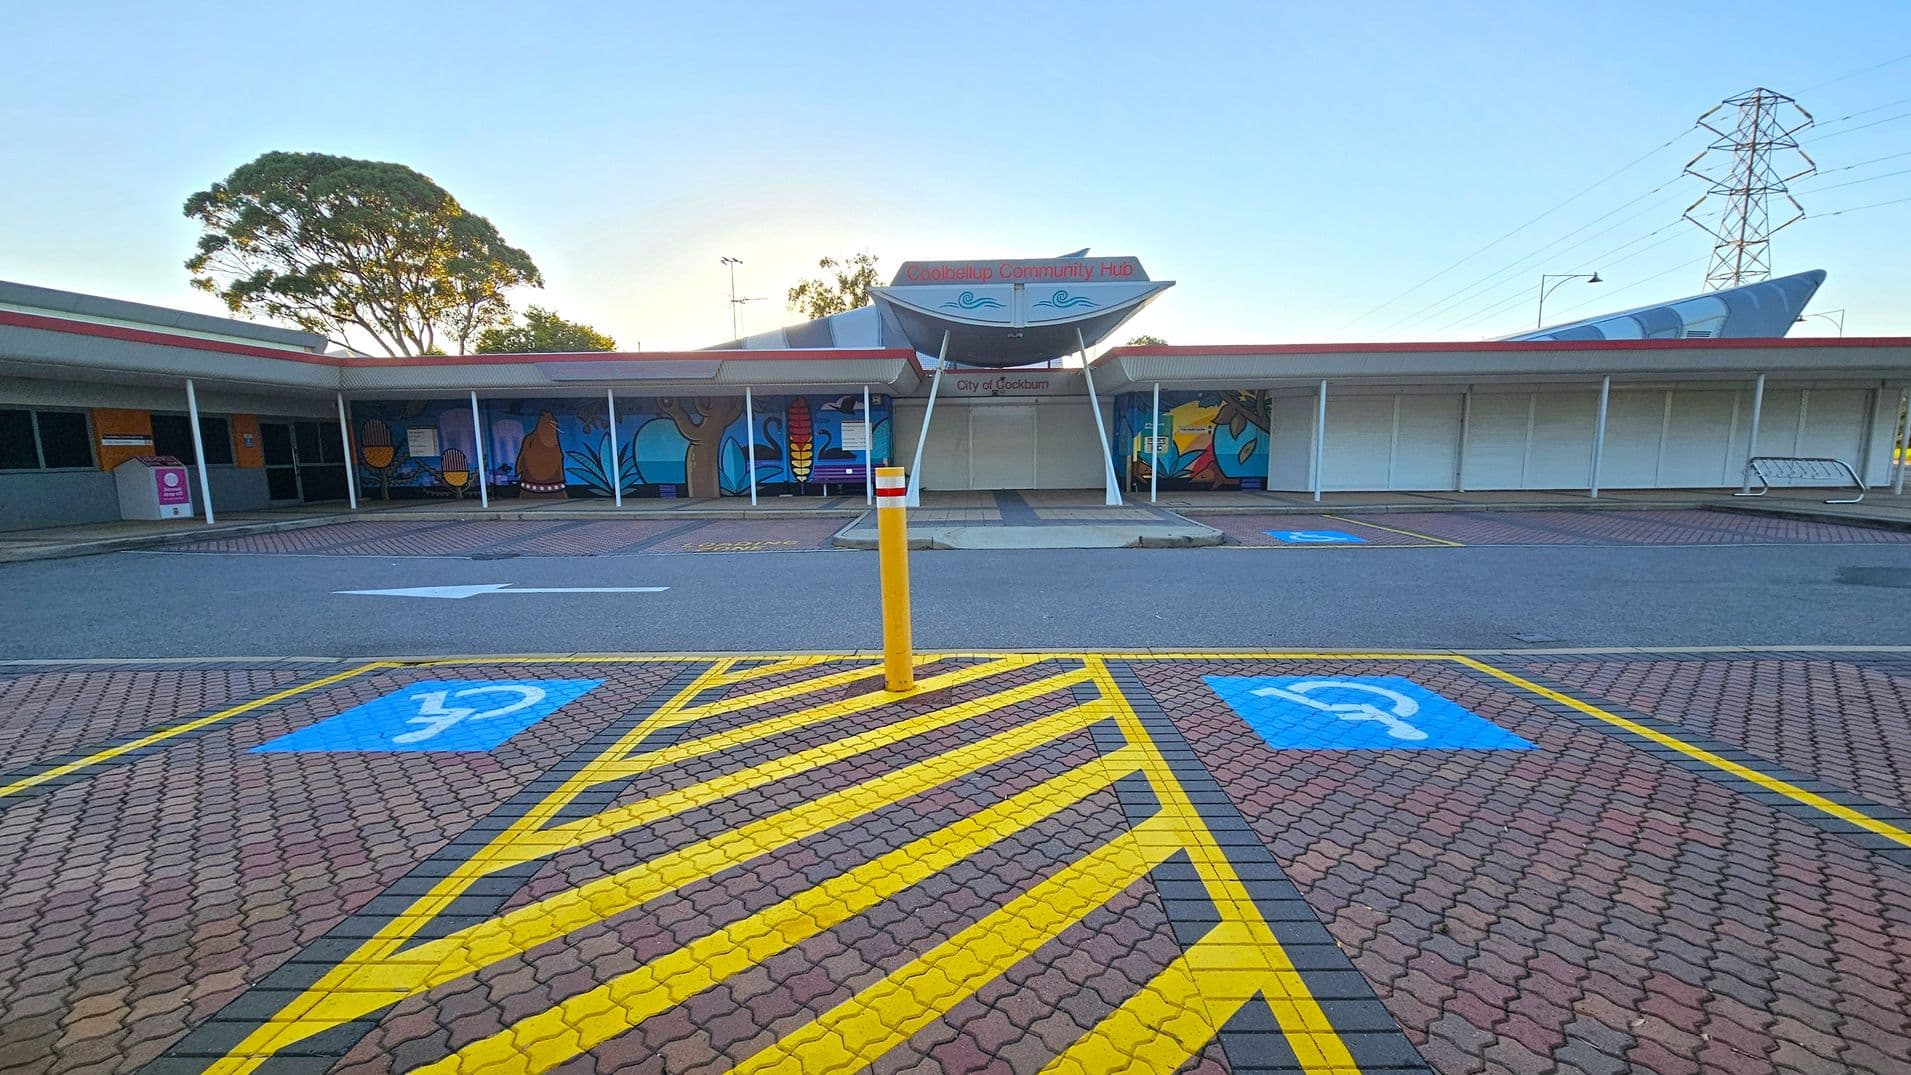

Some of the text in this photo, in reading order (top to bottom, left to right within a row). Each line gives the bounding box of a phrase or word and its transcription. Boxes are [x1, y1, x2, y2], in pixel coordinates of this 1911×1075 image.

[907, 261, 1134, 282] Coolbellup Community Hub
[957, 379, 1049, 392] City of Cockburn
